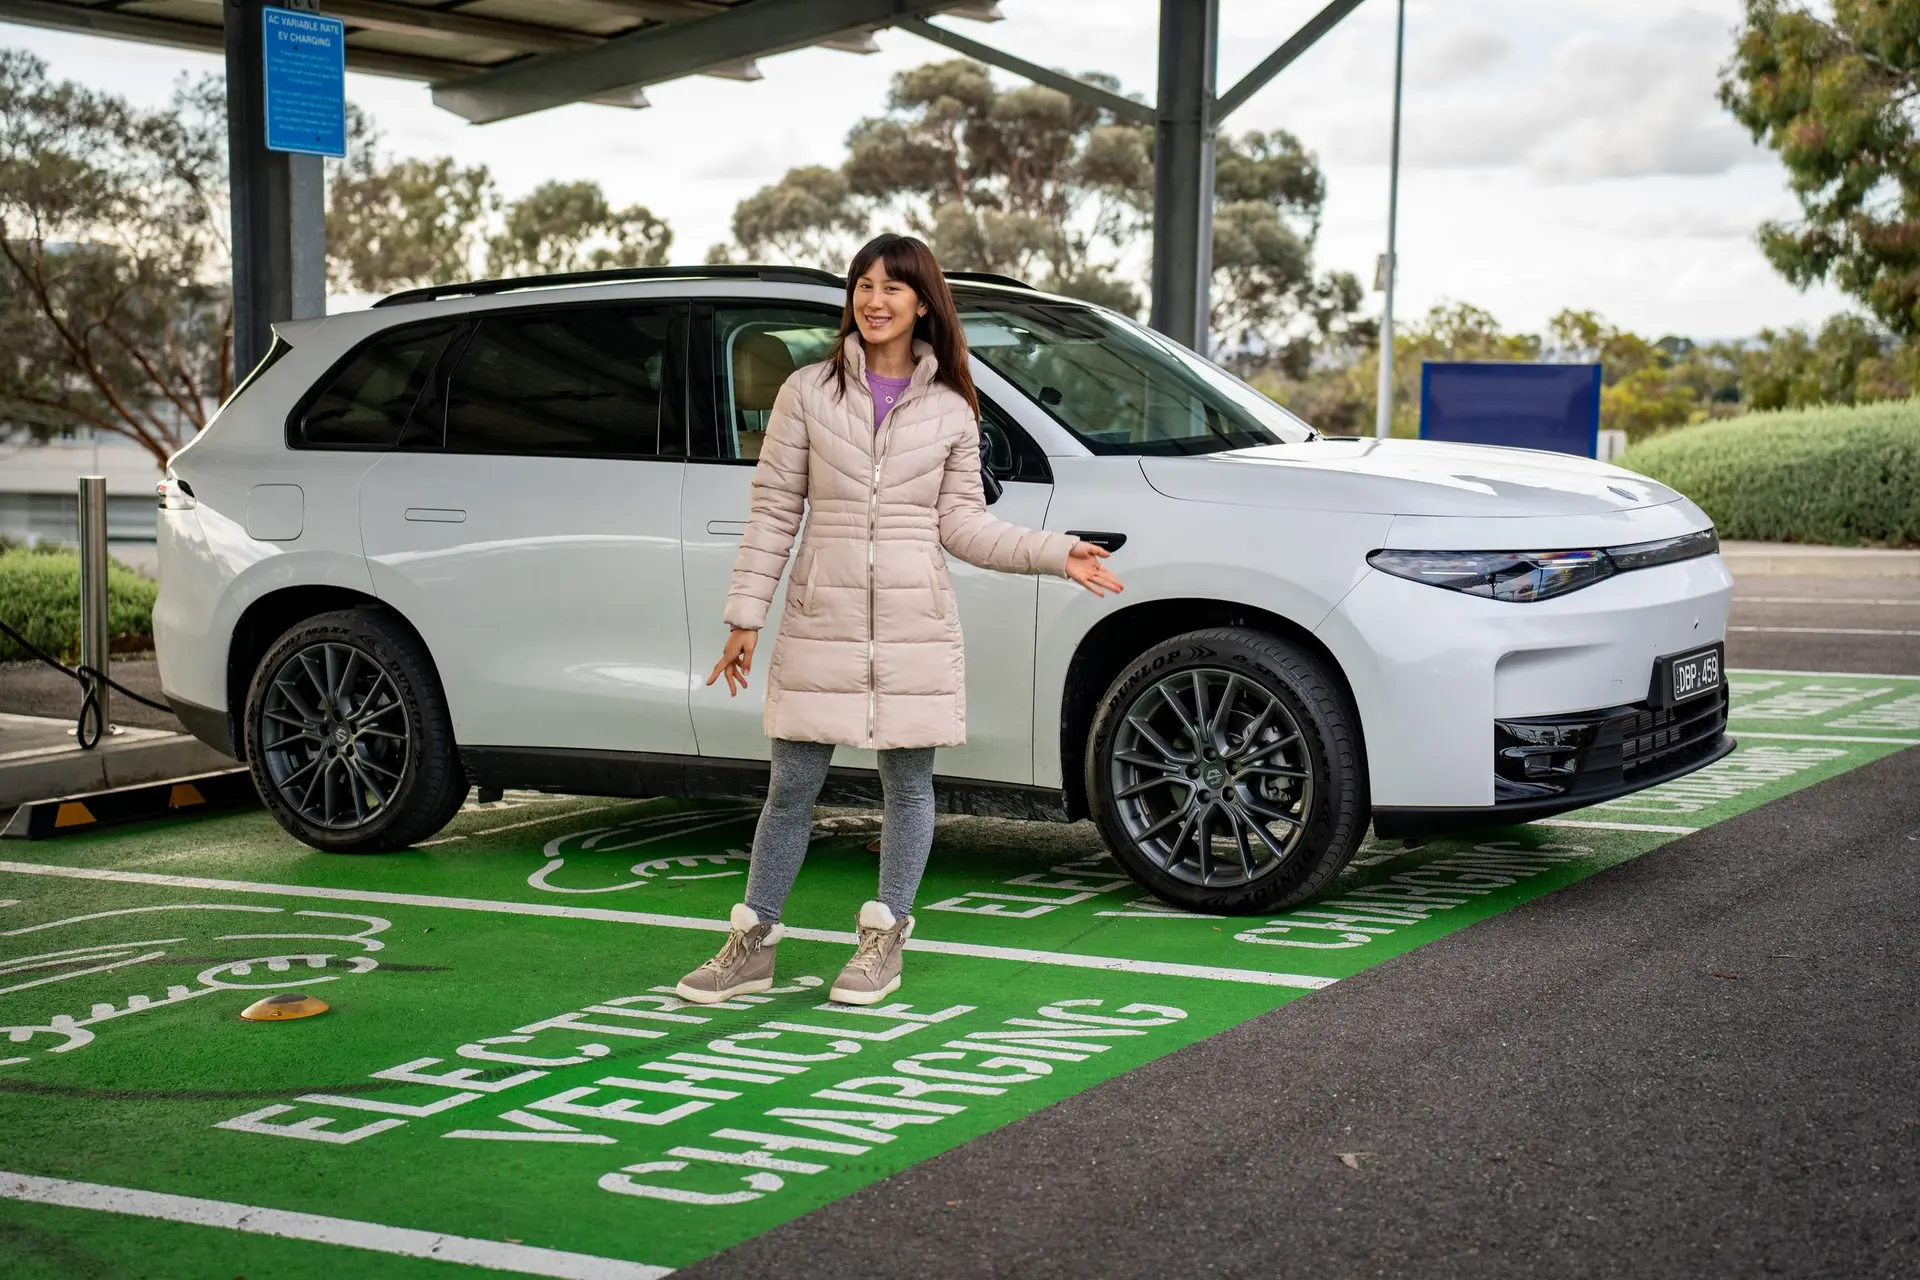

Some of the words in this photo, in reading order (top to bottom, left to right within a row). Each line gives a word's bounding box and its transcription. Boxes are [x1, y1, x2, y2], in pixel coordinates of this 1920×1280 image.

[268, 15, 279, 25] AC
[281, 18, 318, 31] VARIABLE
[320, 23, 340, 35] RATE
[278, 31, 288, 40] EV
[290, 33, 331, 48] CHARGING
[1109, 650, 1181, 713] DUNLOP
[1679, 663, 1697, 692] DBP
[1702, 656, 1717, 684] 459
[1233, 841, 1594, 949] CHARGING
[440, 1002, 978, 1144] VEHICLE
[598, 999, 1188, 1204] CHARGING
